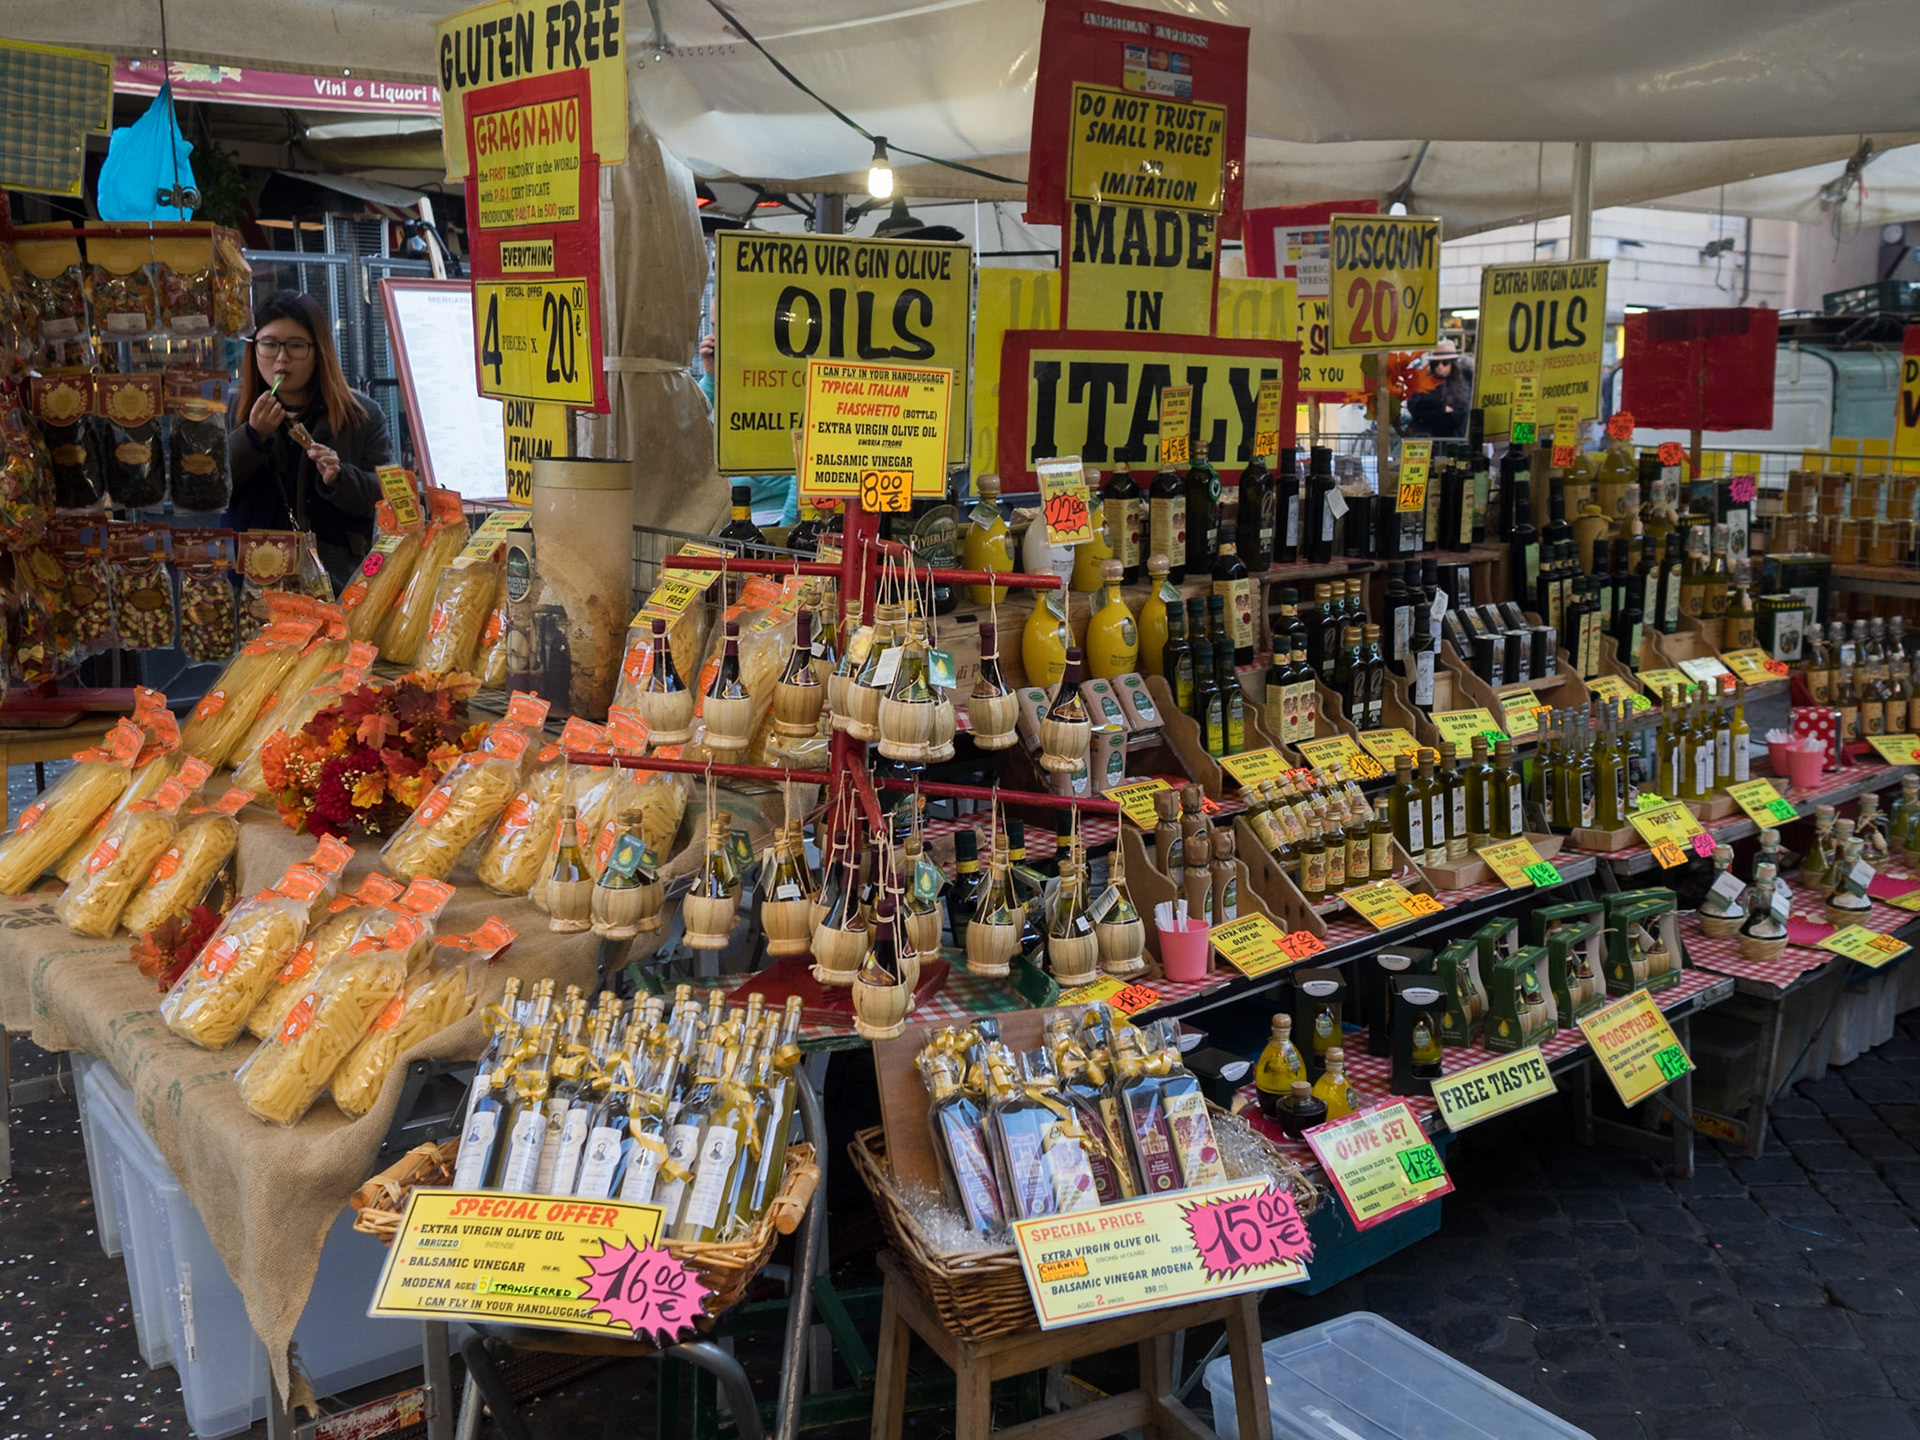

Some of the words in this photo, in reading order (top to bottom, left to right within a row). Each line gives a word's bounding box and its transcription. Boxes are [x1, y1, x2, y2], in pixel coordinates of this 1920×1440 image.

[1083, 12, 1149, 34] AMERICAN
[1154, 23, 1209, 48] EXPRESS
[440, 10, 534, 92] GLUTEN
[546, 0, 620, 70] FREE
[315, 79, 347, 96] Vini
[354, 86, 364, 97] e
[370, 82, 427, 103] Liquori
[1080, 93, 1106, 117] DO
[1112, 97, 1150, 122] NOT
[1156, 104, 1206, 132] TRUST
[1209, 121, 1221, 134] IN
[476, 100, 577, 156] GRAGNANO
[1086, 121, 1146, 148] SMALL
[1154, 130, 1213, 157] PRICES
[489, 166, 506, 181] FIRST
[508, 162, 534, 178] FACTORY
[536, 162, 542, 174] in
[543, 160, 552, 174] the
[554, 156, 578, 172] WORLD
[480, 188, 494, 202] with
[1100, 172, 1197, 202] IMITATION
[514, 205, 536, 220] PASTA
[537, 204, 544, 217] in
[544, 203, 557, 216] 500
[558, 204, 575, 220] years
[1072, 204, 1214, 270] MADE
[502, 244, 552, 268] EVERYTHING
[1335, 224, 1438, 272] DISCOUNT
[736, 241, 808, 274] EXTRA
[895, 250, 951, 280] OLIVE
[1493, 271, 1528, 296] EXTRA
[1570, 267, 1598, 288] OLIVE
[506, 286, 524, 298] SPECIAL
[527, 286, 543, 298] OFFER
[1125, 290, 1163, 331] IN
[774, 286, 936, 360] OILS
[1508, 295, 1588, 352] OILS
[483, 291, 502, 386] 4
[502, 335, 527, 352] PIECES
[1490, 362, 1512, 376] FIRST
[1543, 354, 1572, 368] PRESSED
[1574, 352, 1598, 366] OLIVE
[742, 370, 788, 388] FIRST
[823, 368, 840, 377] CAN
[842, 369, 856, 378] FLY
[859, 370, 867, 378] IN
[870, 370, 890, 380] YOUR
[892, 372, 944, 384] HANDLUGGAGE
[1320, 368, 1344, 382] YOU
[820, 380, 864, 396] TYPICAL
[868, 382, 909, 397] ITALIAN
[1542, 382, 1588, 399] PRODUCTION
[836, 402, 900, 417] FIASCHETTO
[902, 410, 937, 420] (BOTTLE)
[1482, 394, 1508, 408] SMALL
[507, 401, 534, 428] ONLY
[730, 412, 785, 430] SMALL
[1031, 361, 1278, 464] ITALY
[818, 422, 852, 435] EXTRA
[855, 423, 888, 436] VIRGIN
[892, 425, 920, 437] OLIVE
[922, 426, 937, 438] OIL
[509, 436, 552, 464] ITALIAN
[882, 440, 902, 448] STRONG
[816, 454, 868, 466] BALSAMIC
[872, 455, 912, 468] VINEGAR
[814, 471, 858, 484] MODENA
[470, 540, 494, 548] GLUTEN
[664, 582, 692, 594] GLUTEN
[666, 594, 686, 606] FREE
[1458, 714, 1478, 722] VIRGIN
[1231, 758, 1250, 766] EXTRA
[1249, 754, 1268, 762] VIRGIN
[1114, 789, 1136, 798] EXTRA
[1136, 784, 1160, 792] VIRGIN
[1129, 794, 1149, 803] OLIVE
[1646, 811, 1682, 827] TRUFFLE
[1356, 892, 1376, 902] EXTRA
[1374, 888, 1394, 897] VIRGIN
[1368, 898, 1386, 906] OLIVE
[1217, 930, 1238, 942] EXTRA
[1238, 922, 1260, 933] VIRGIN
[1232, 935, 1252, 946] OLIVE
[1250, 931, 1263, 941] OIL
[1597, 1010, 1660, 1050] TOGETHER
[1440, 1078, 1490, 1114] FREE
[1487, 1058, 1546, 1096] TASTE
[1335, 1128, 1381, 1160] OLIVE
[1382, 1118, 1408, 1144] SET
[1344, 1168, 1359, 1180] EXTRA
[1358, 1164, 1374, 1174] VIRGIN
[1372, 1158, 1388, 1169] OLIVE
[1356, 1188, 1378, 1202] BALSAMIC
[1376, 1181, 1396, 1195] VINEGAR
[449, 1197, 539, 1222] SPECIAL
[547, 1204, 619, 1228] OFFER
[1362, 1200, 1380, 1214] MODENA
[420, 1223, 458, 1235] EXTRA
[462, 1224, 503, 1238] VIRGIN
[506, 1228, 542, 1240] OLIVE
[545, 1230, 566, 1242] OIL
[1031, 1220, 1096, 1243] SPECIAL
[1098, 1211, 1146, 1232] PRICE
[418, 1238, 460, 1248] ABRUZZO
[1042, 1249, 1074, 1264] EXTRA
[1075, 1242, 1110, 1258] VIRGIN
[1113, 1238, 1142, 1252] OLIVE
[1144, 1233, 1162, 1247] OIL
[409, 1256, 470, 1269] BALSAMIC
[473, 1258, 526, 1273] VINEGAR
[1040, 1260, 1080, 1274] CHIANTI
[401, 1277, 451, 1290] MODENA
[495, 1283, 572, 1298] TRANSFERRED
[1052, 1276, 1102, 1296] BALSAMIC
[1104, 1269, 1149, 1285] VINEGAR
[1151, 1260, 1194, 1277] MODENA
[425, 1296, 446, 1306] CAN
[448, 1298, 468, 1308] FLY
[471, 1299, 483, 1309] IN
[486, 1300, 514, 1312] YOUR
[516, 1302, 594, 1320] HANDLUGGAGE
[1096, 1294, 1106, 1306] 2
